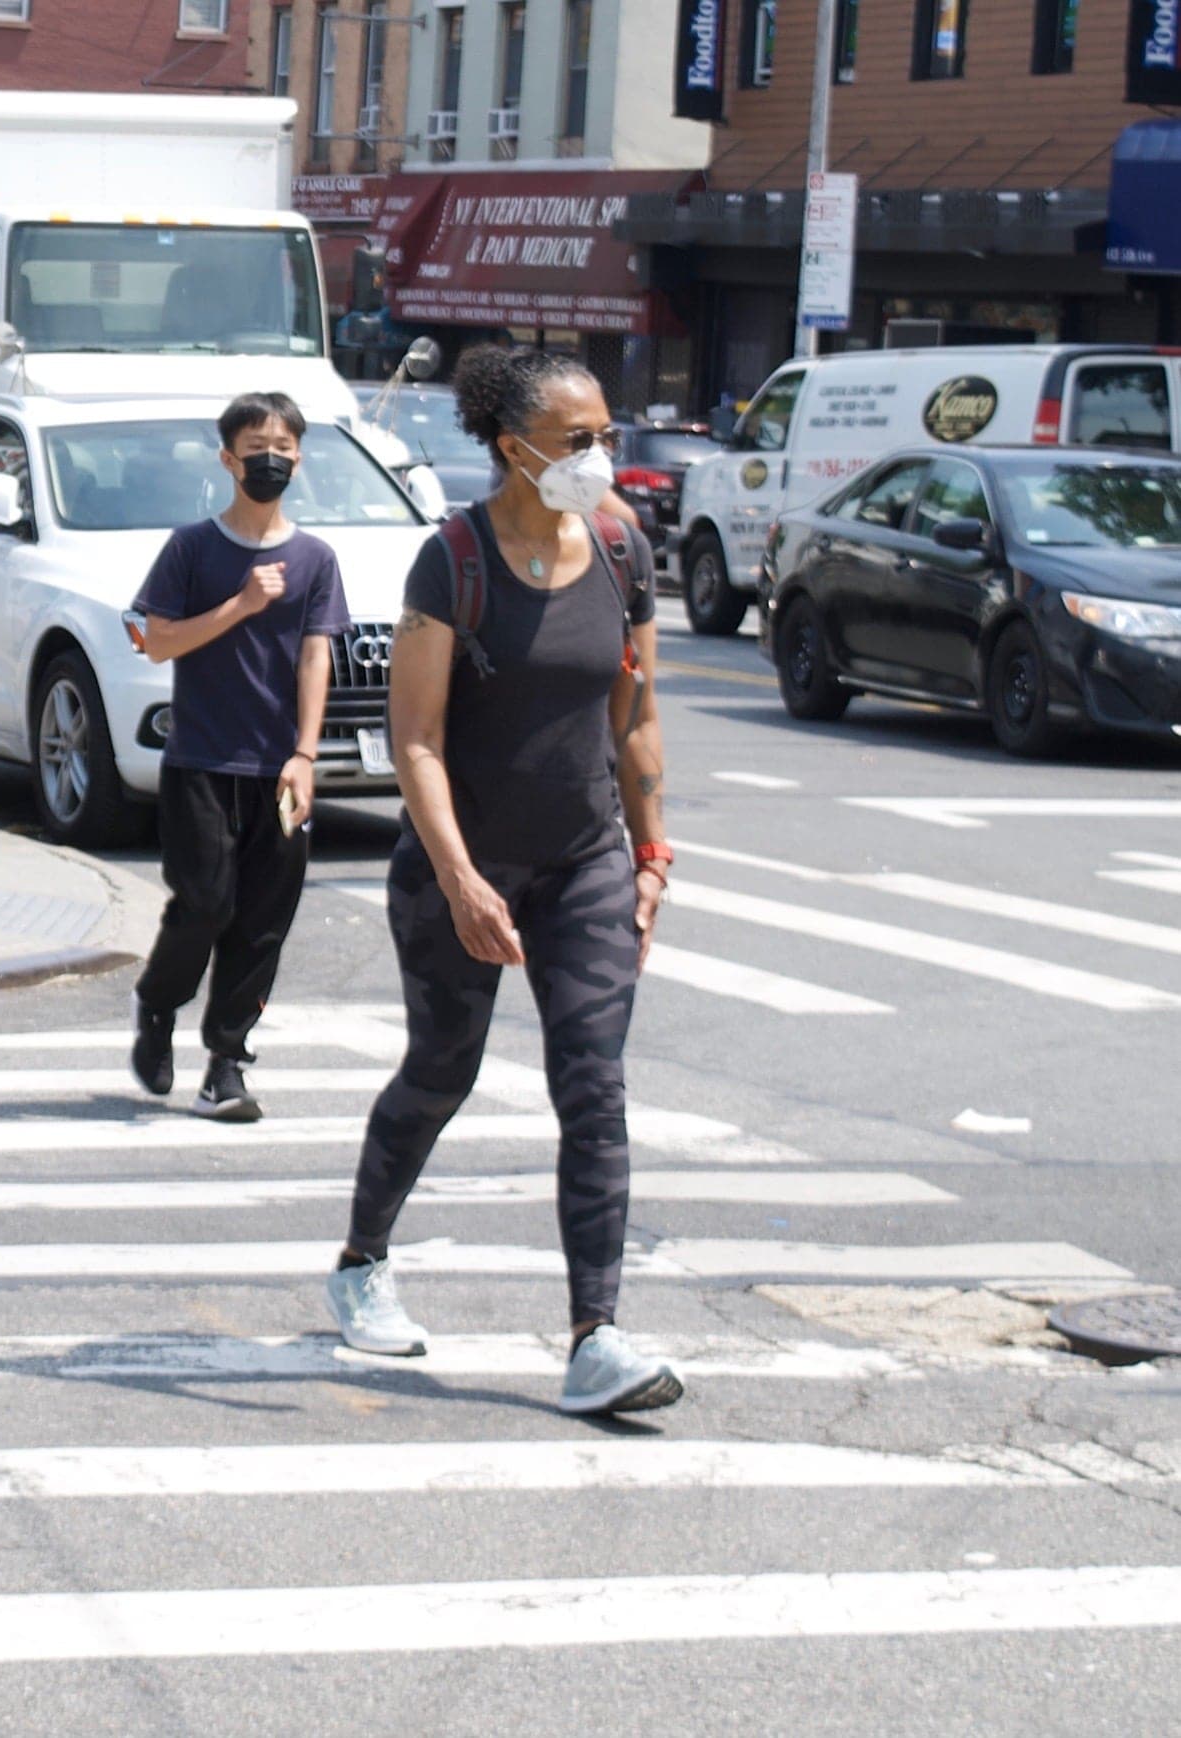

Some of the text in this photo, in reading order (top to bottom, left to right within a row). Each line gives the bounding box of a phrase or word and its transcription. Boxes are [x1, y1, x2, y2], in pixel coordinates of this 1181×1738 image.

[474, 197, 596, 226] INTERVENTIONAL
[466, 235, 482, 264] &
[482, 236, 519, 265] PAIN
[517, 237, 595, 268] MEDICINE
[928, 379, 993, 421] Kamco
